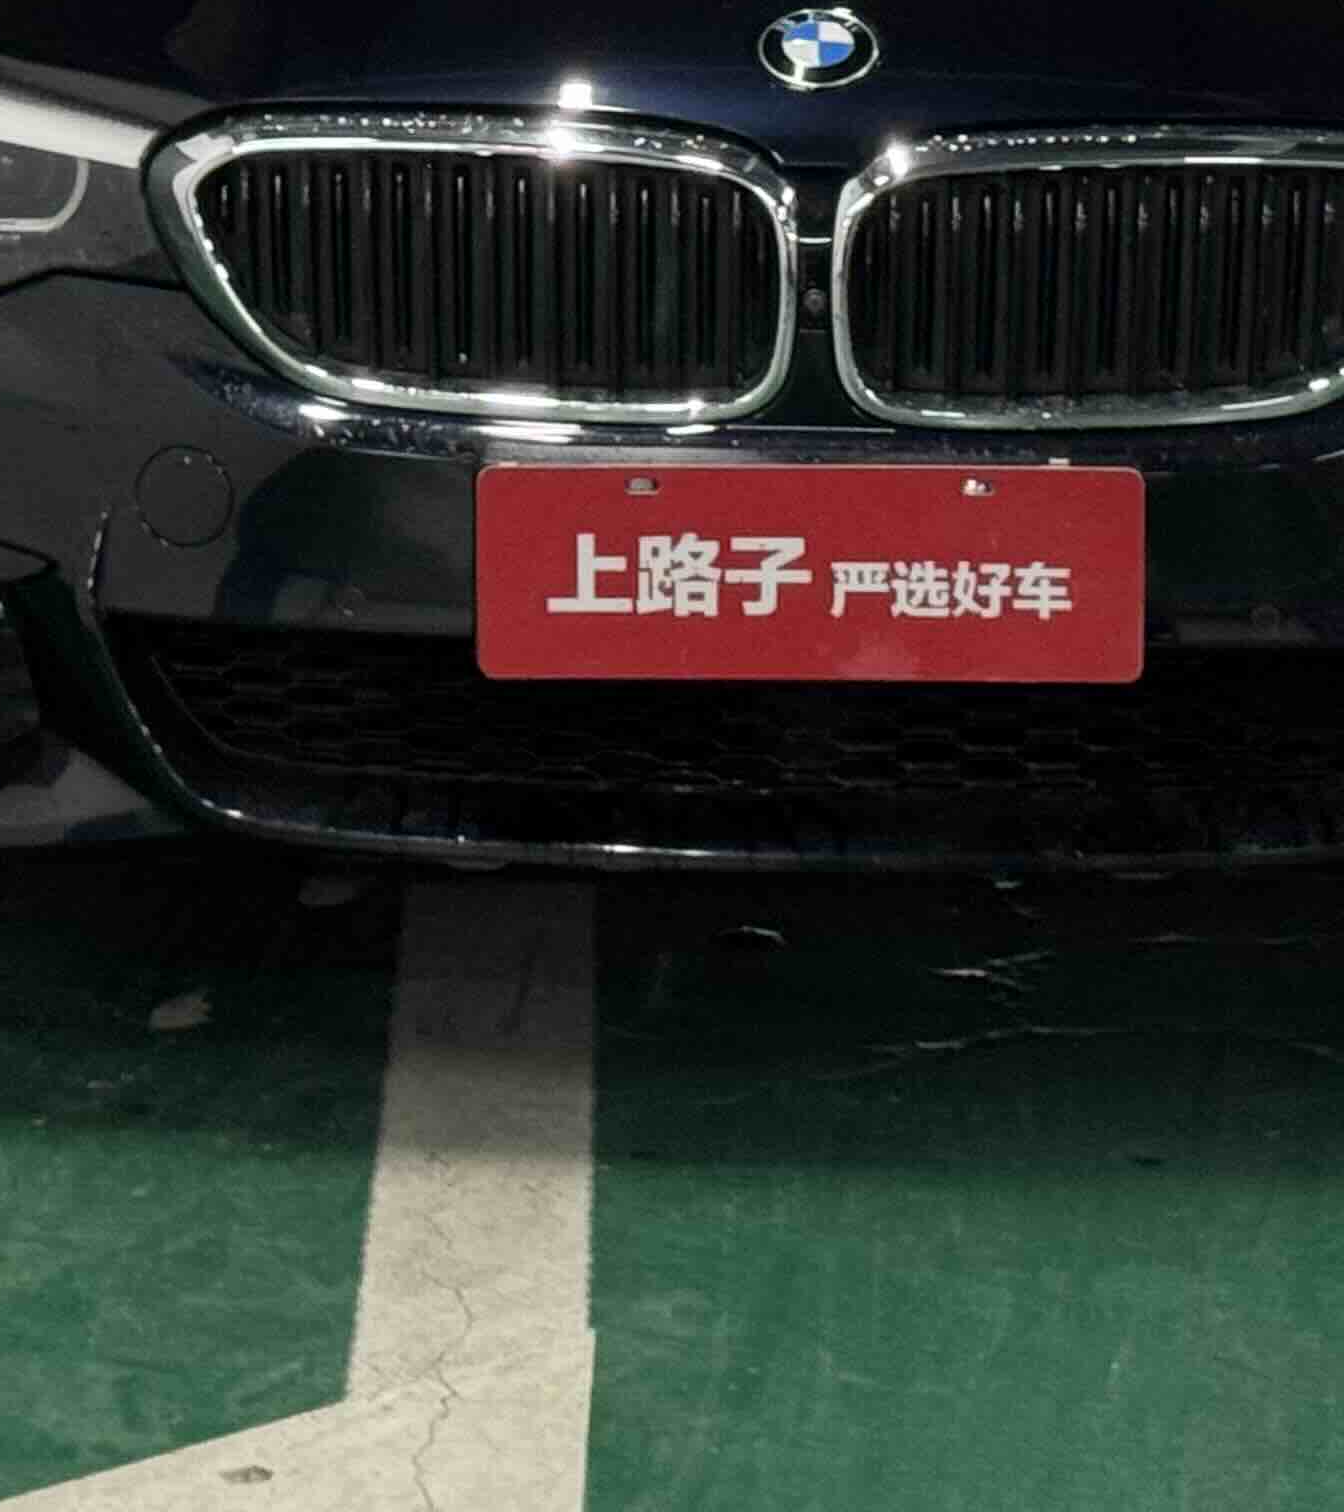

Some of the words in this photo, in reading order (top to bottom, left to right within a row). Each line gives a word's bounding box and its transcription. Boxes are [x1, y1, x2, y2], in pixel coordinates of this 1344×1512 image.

[547, 532, 813, 617] 上路子
[830, 560, 1073, 620] 严选好车
